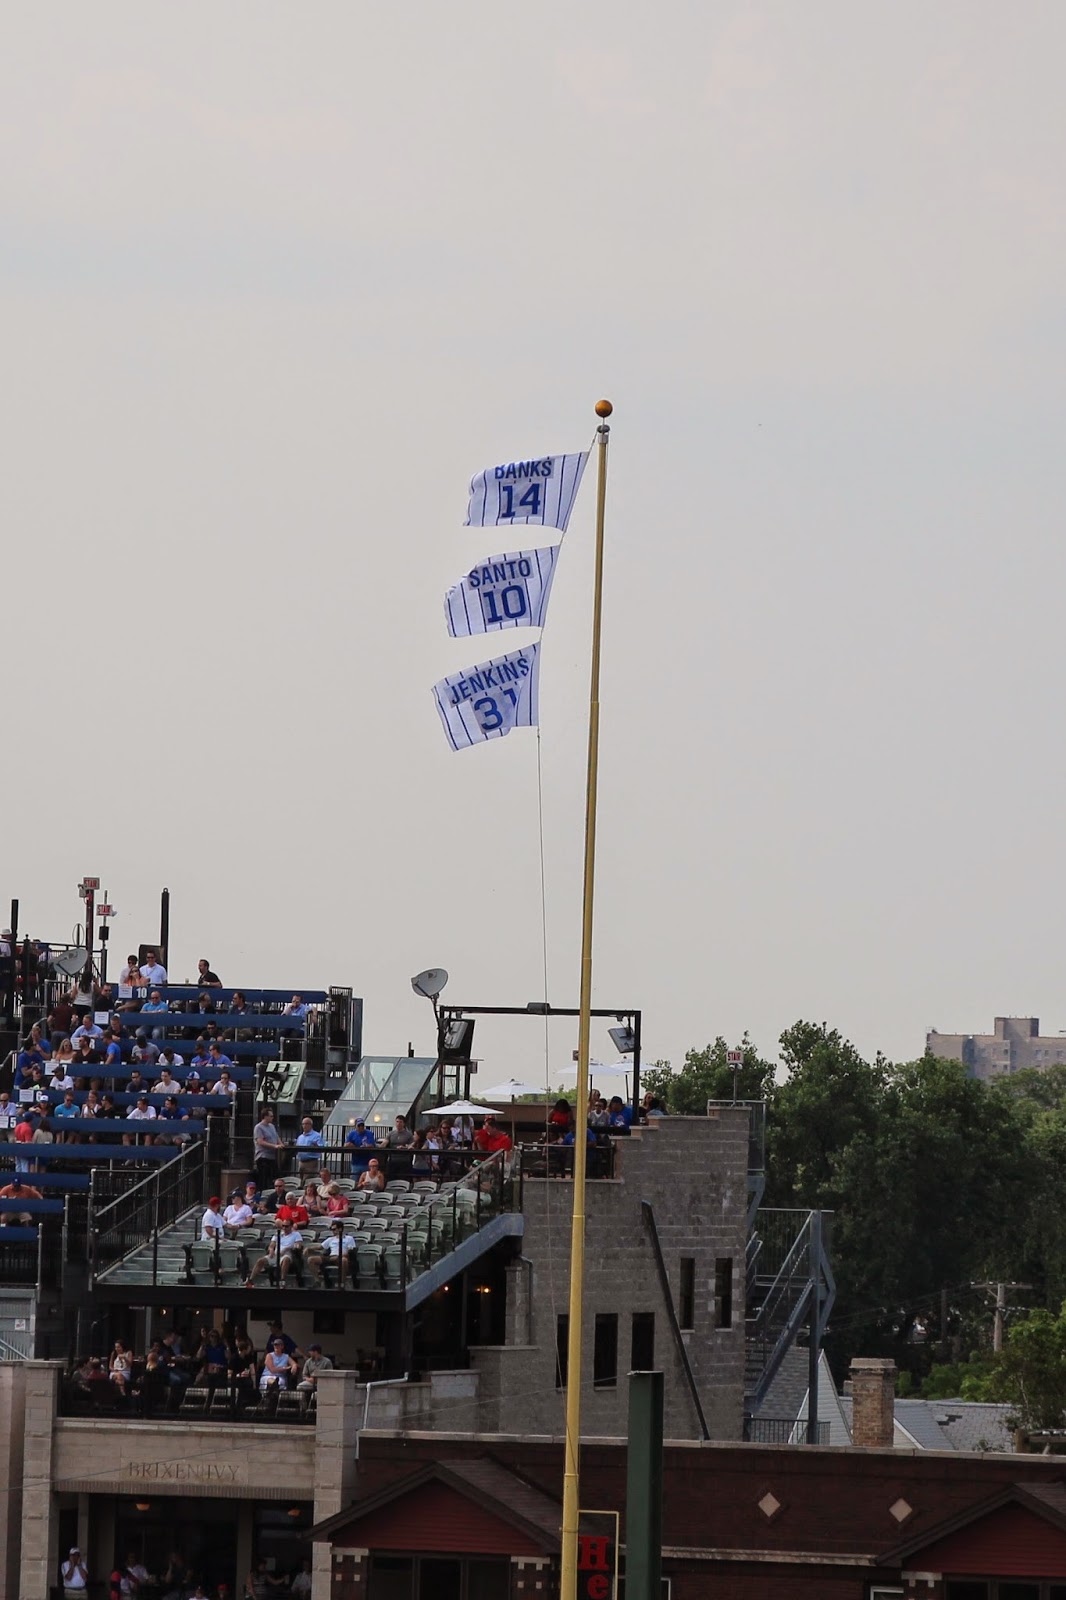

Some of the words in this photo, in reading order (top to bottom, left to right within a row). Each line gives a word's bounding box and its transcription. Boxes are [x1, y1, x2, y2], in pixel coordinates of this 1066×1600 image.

[501, 483, 541, 518] 14
[469, 558, 531, 588] SANTO
[482, 585, 527, 623] 10
[451, 658, 530, 704] JENKINS
[136, 987, 148, 999] 10
[10, 1117, 17, 1128] 5
[128, 1461, 201, 1479] BRIXEN
[206, 1464, 240, 1481] IVY
